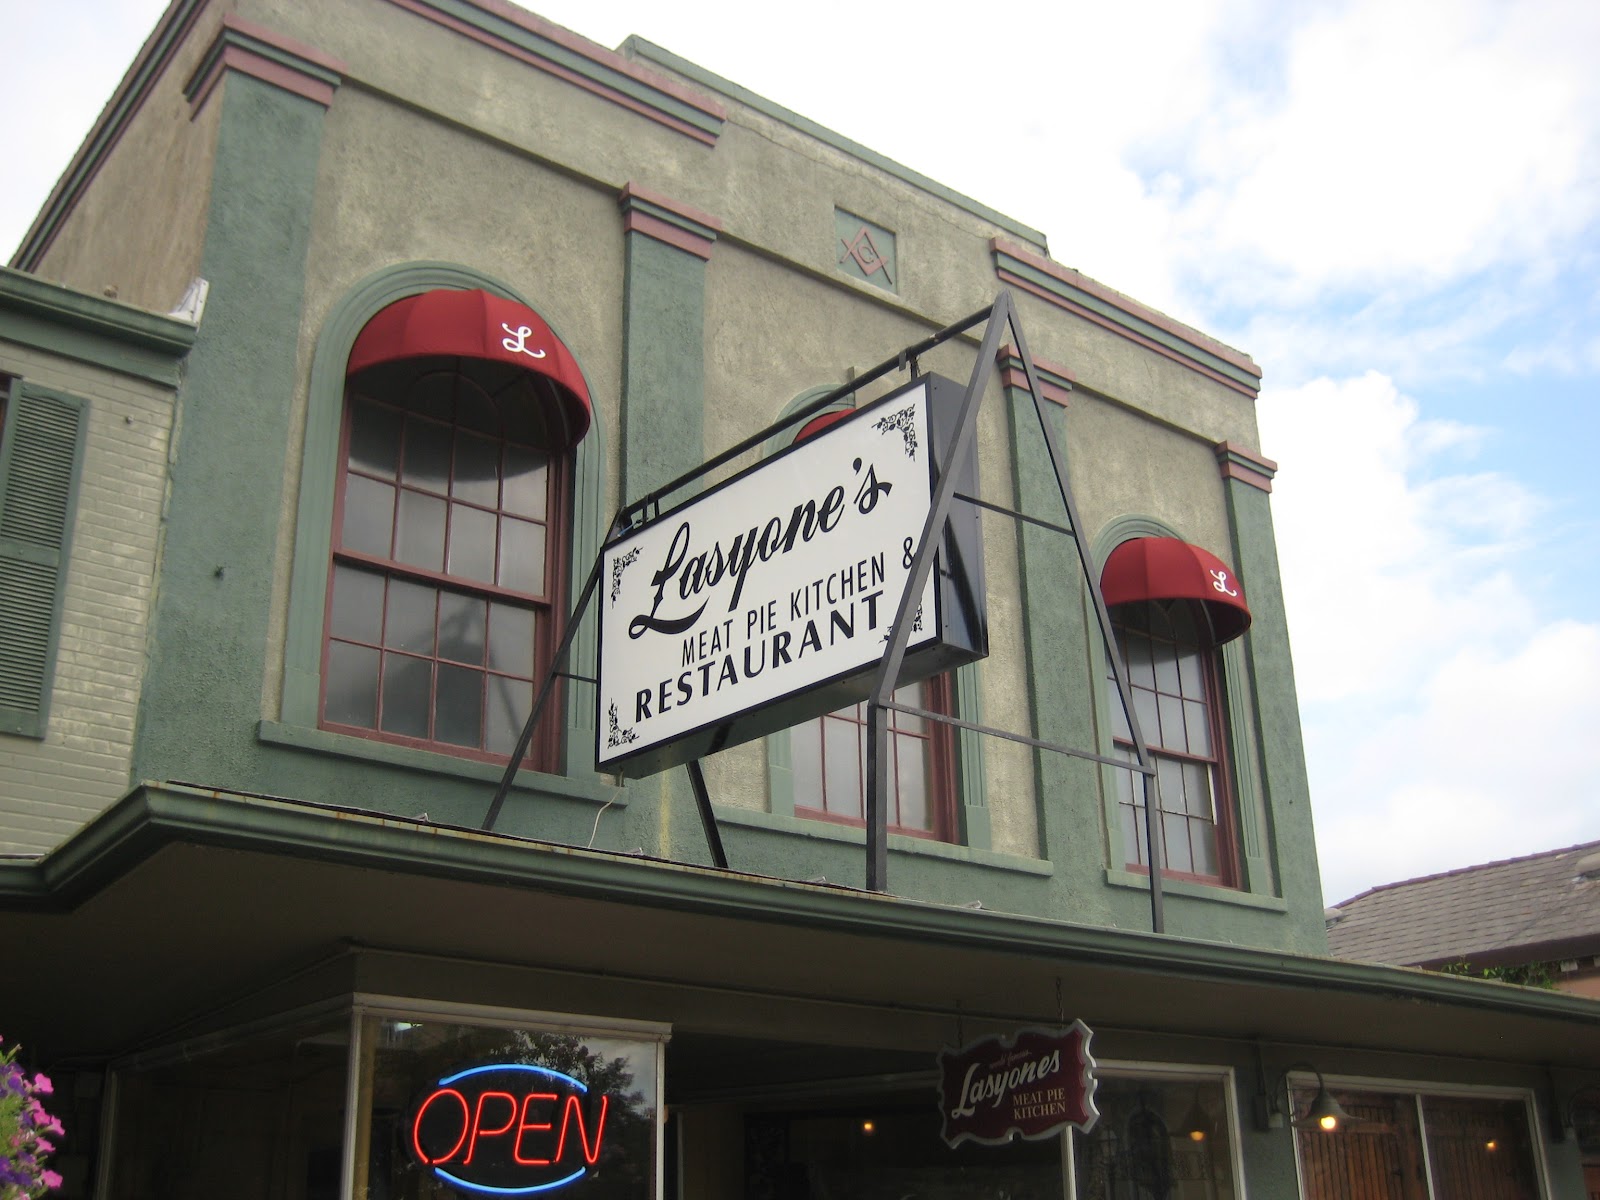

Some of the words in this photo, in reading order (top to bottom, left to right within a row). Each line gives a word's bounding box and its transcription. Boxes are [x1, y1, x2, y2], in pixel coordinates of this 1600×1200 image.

[501, 322, 546, 359] L
[628, 457, 893, 640] Lasyone's
[682, 619, 734, 668] MEAT
[747, 600, 778, 640] PIE
[790, 551, 885, 618] KITCHEN
[902, 536, 916, 570] &
[635, 590, 884, 723] RESTAURANT
[951, 1049, 1060, 1120] Lasyones
[1012, 1091, 1044, 1106] MEAT
[1047, 1087, 1065, 1101] PIE
[1013, 1101, 1066, 1120] KITCHEN
[413, 1088, 608, 1164] OPEN
